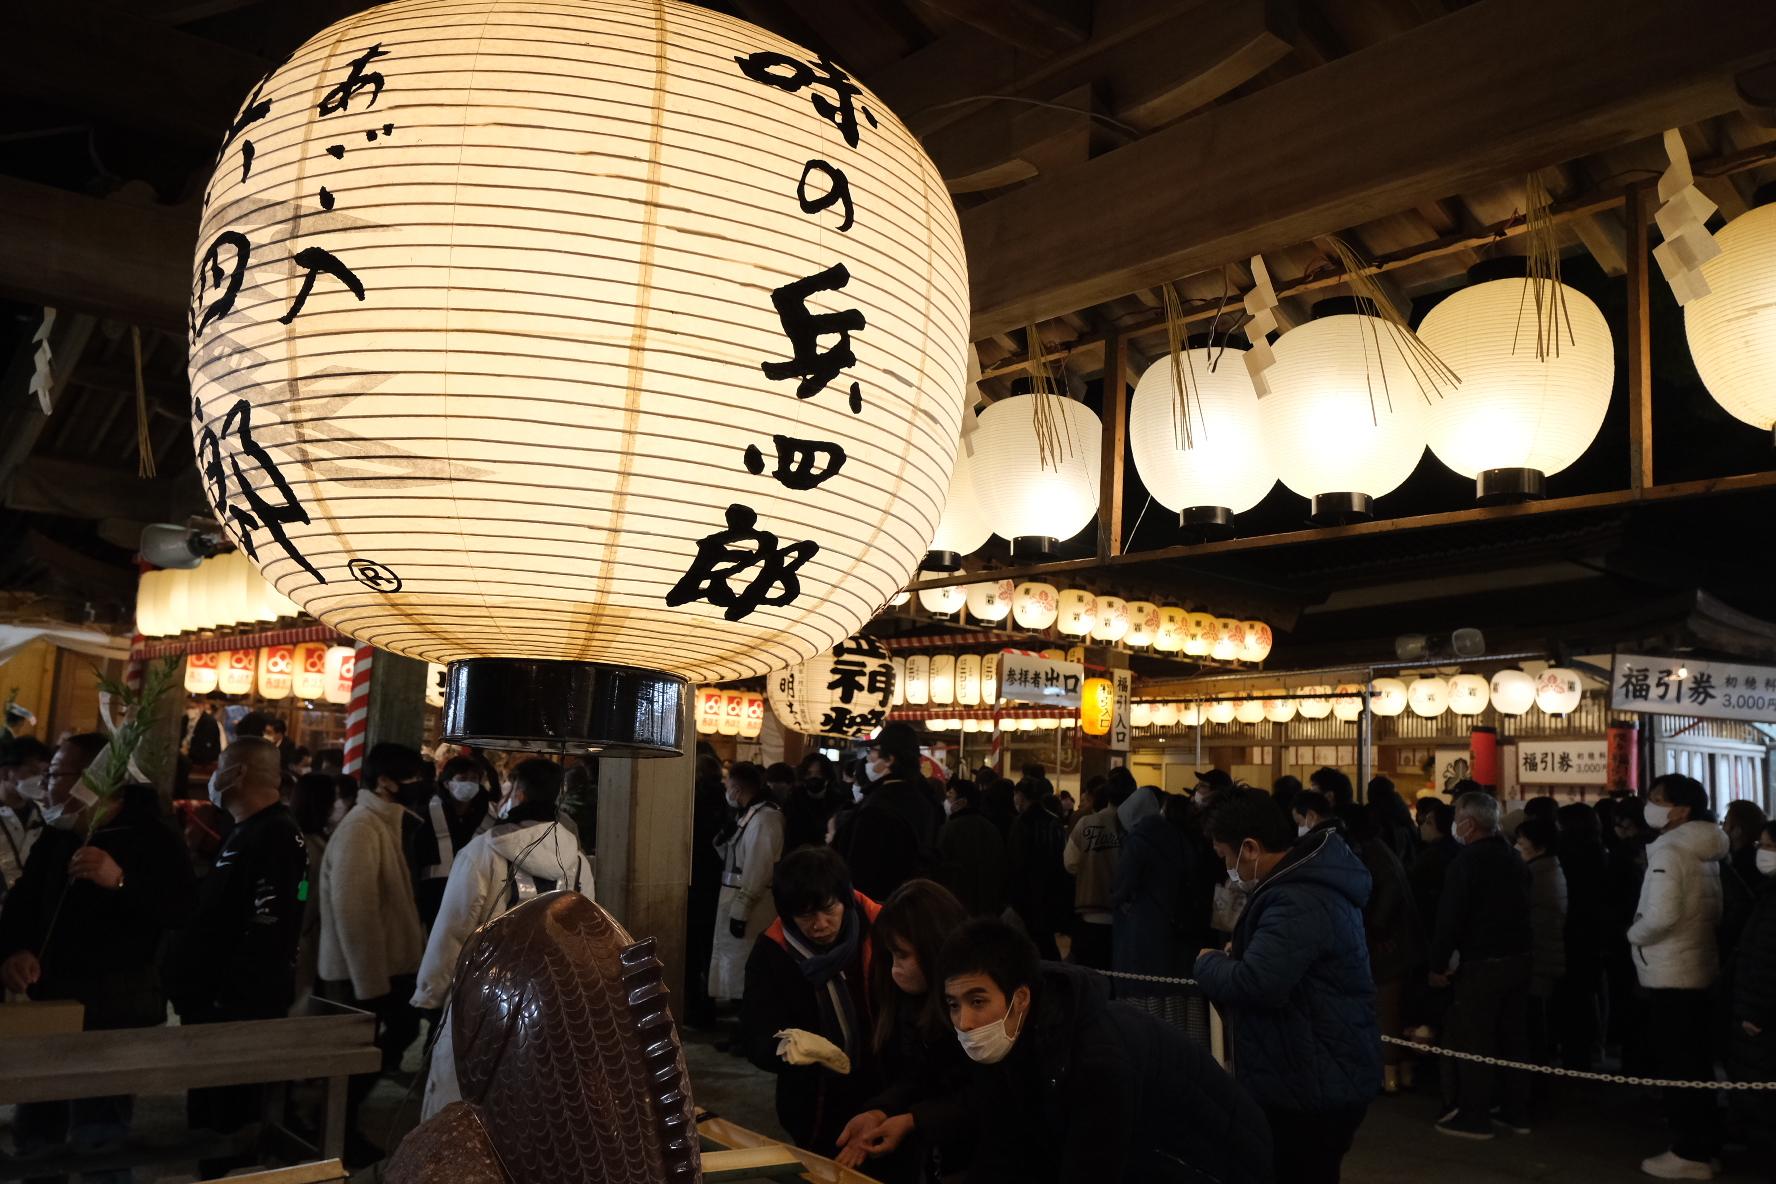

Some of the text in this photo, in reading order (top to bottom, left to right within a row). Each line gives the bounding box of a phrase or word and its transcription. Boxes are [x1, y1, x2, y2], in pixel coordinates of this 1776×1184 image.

[665, 51, 878, 622] 味の兵四郎
[1006, 667, 1080, 693] 参拝者出口
[1620, 666, 1717, 706] 福引券
[1115, 675, 1129, 743] 福引入口
[1522, 750, 1574, 773] 福引券
